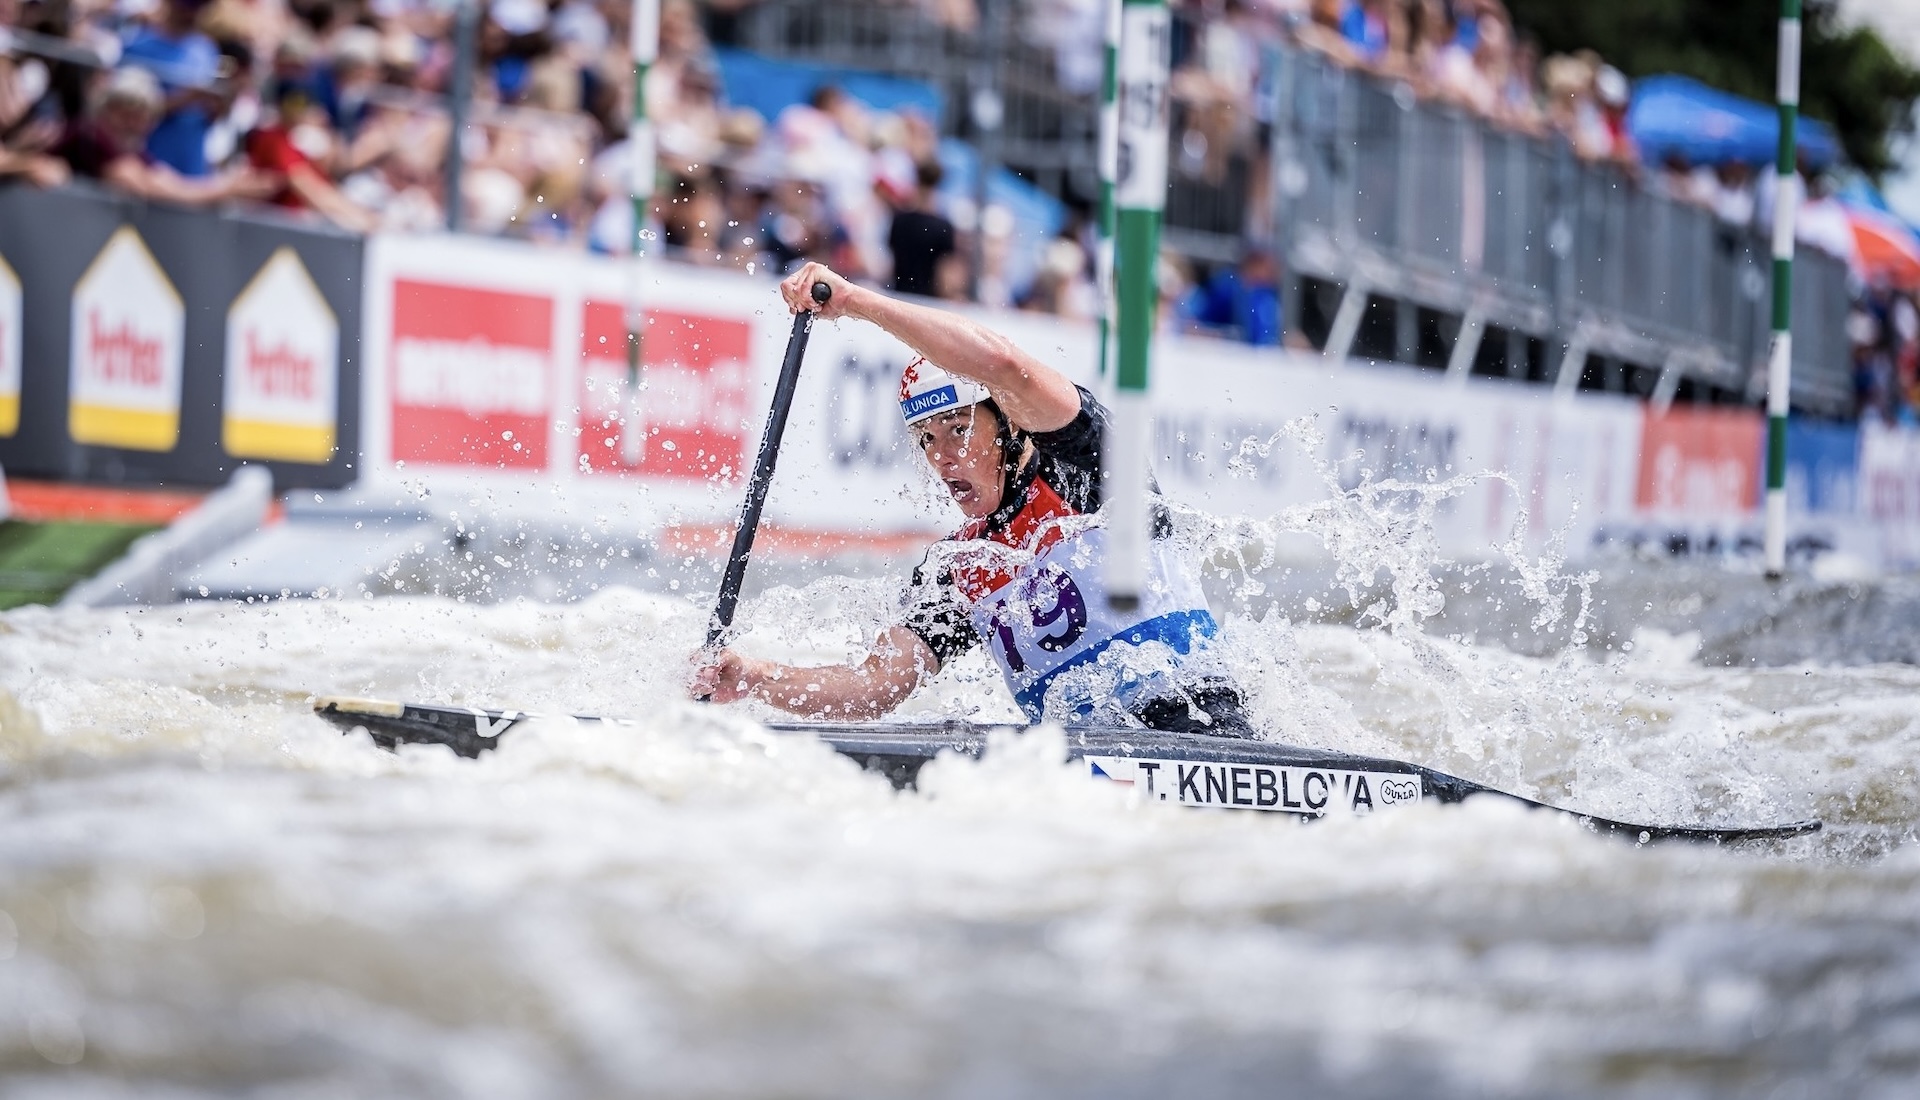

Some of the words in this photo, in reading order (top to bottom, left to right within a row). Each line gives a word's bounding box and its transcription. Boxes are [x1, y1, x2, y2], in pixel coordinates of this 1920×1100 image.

[911, 391, 950, 413] UNIQA
[988, 565, 1087, 673] 19
[1138, 762, 1166, 801] T.
[1384, 785, 1415, 800] DUKLA
